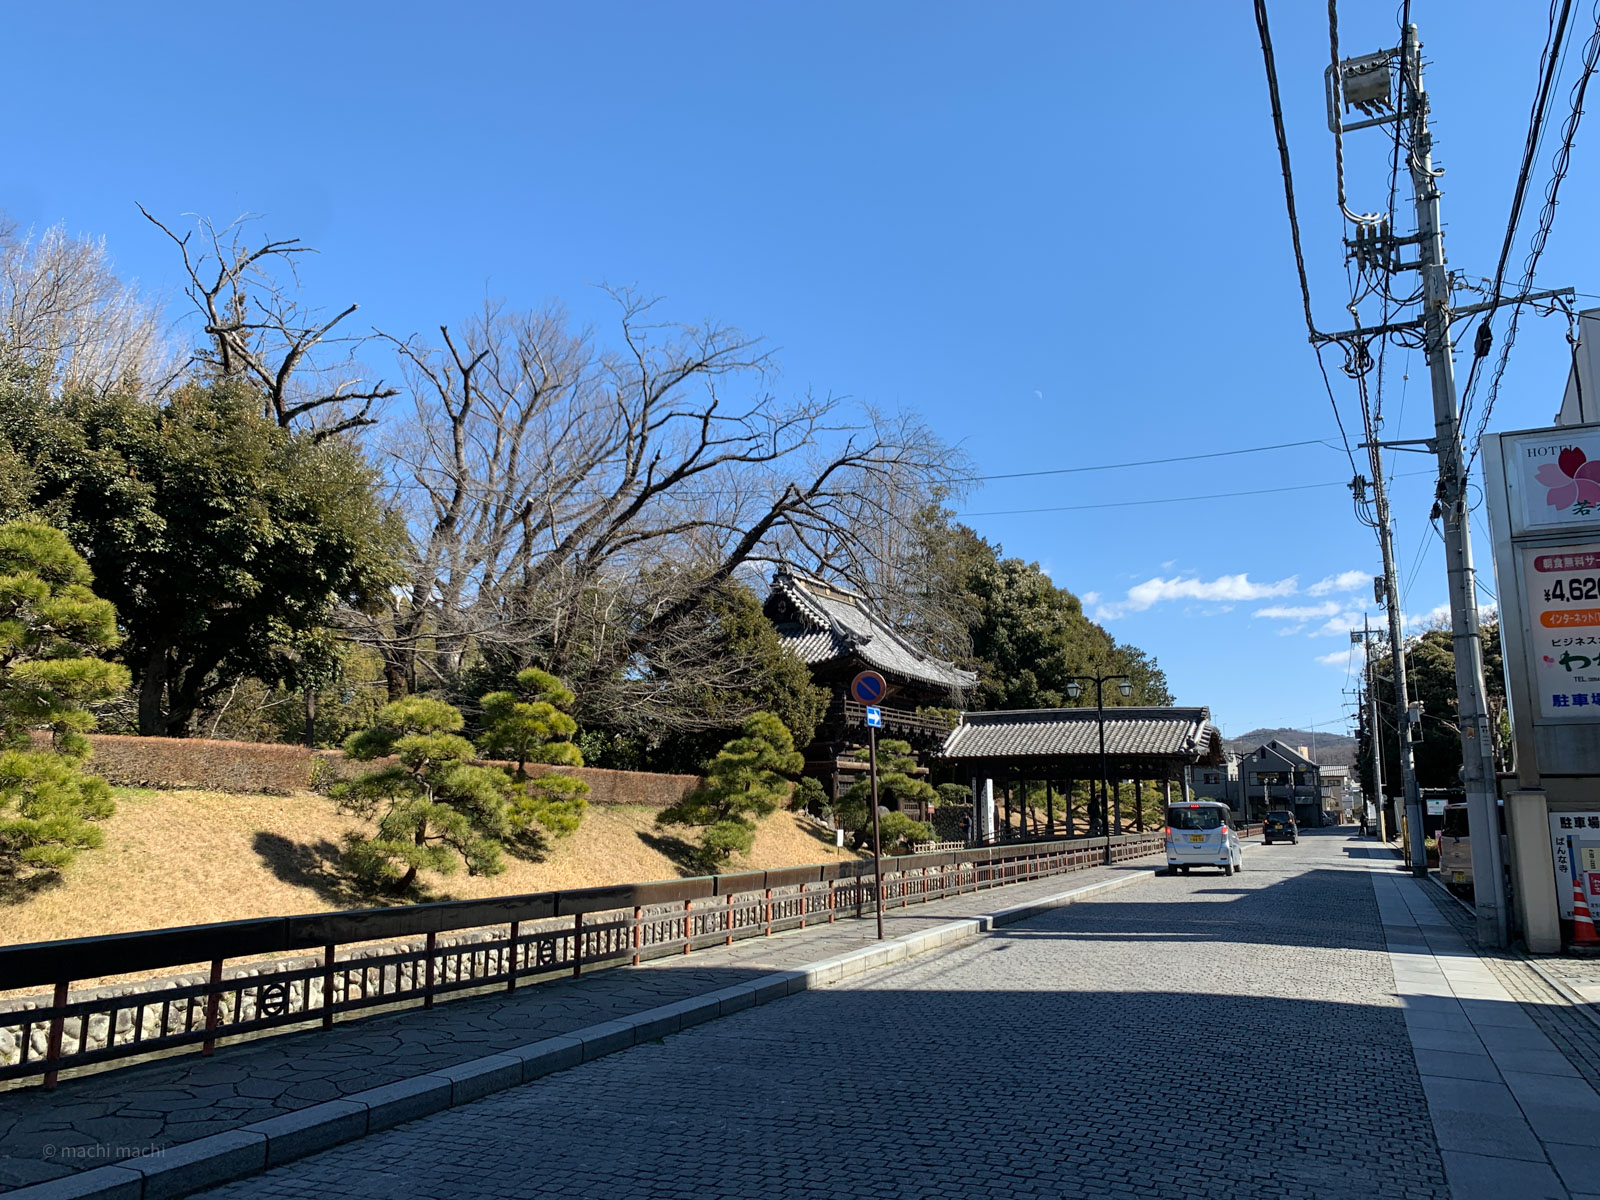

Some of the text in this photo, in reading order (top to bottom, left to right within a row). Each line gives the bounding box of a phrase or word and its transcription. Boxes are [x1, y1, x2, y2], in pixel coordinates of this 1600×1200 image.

[1572, 500, 1600, 515] 若
[1552, 636, 1600, 647] ビジネス
[1560, 816, 1600, 829] 駐車場
